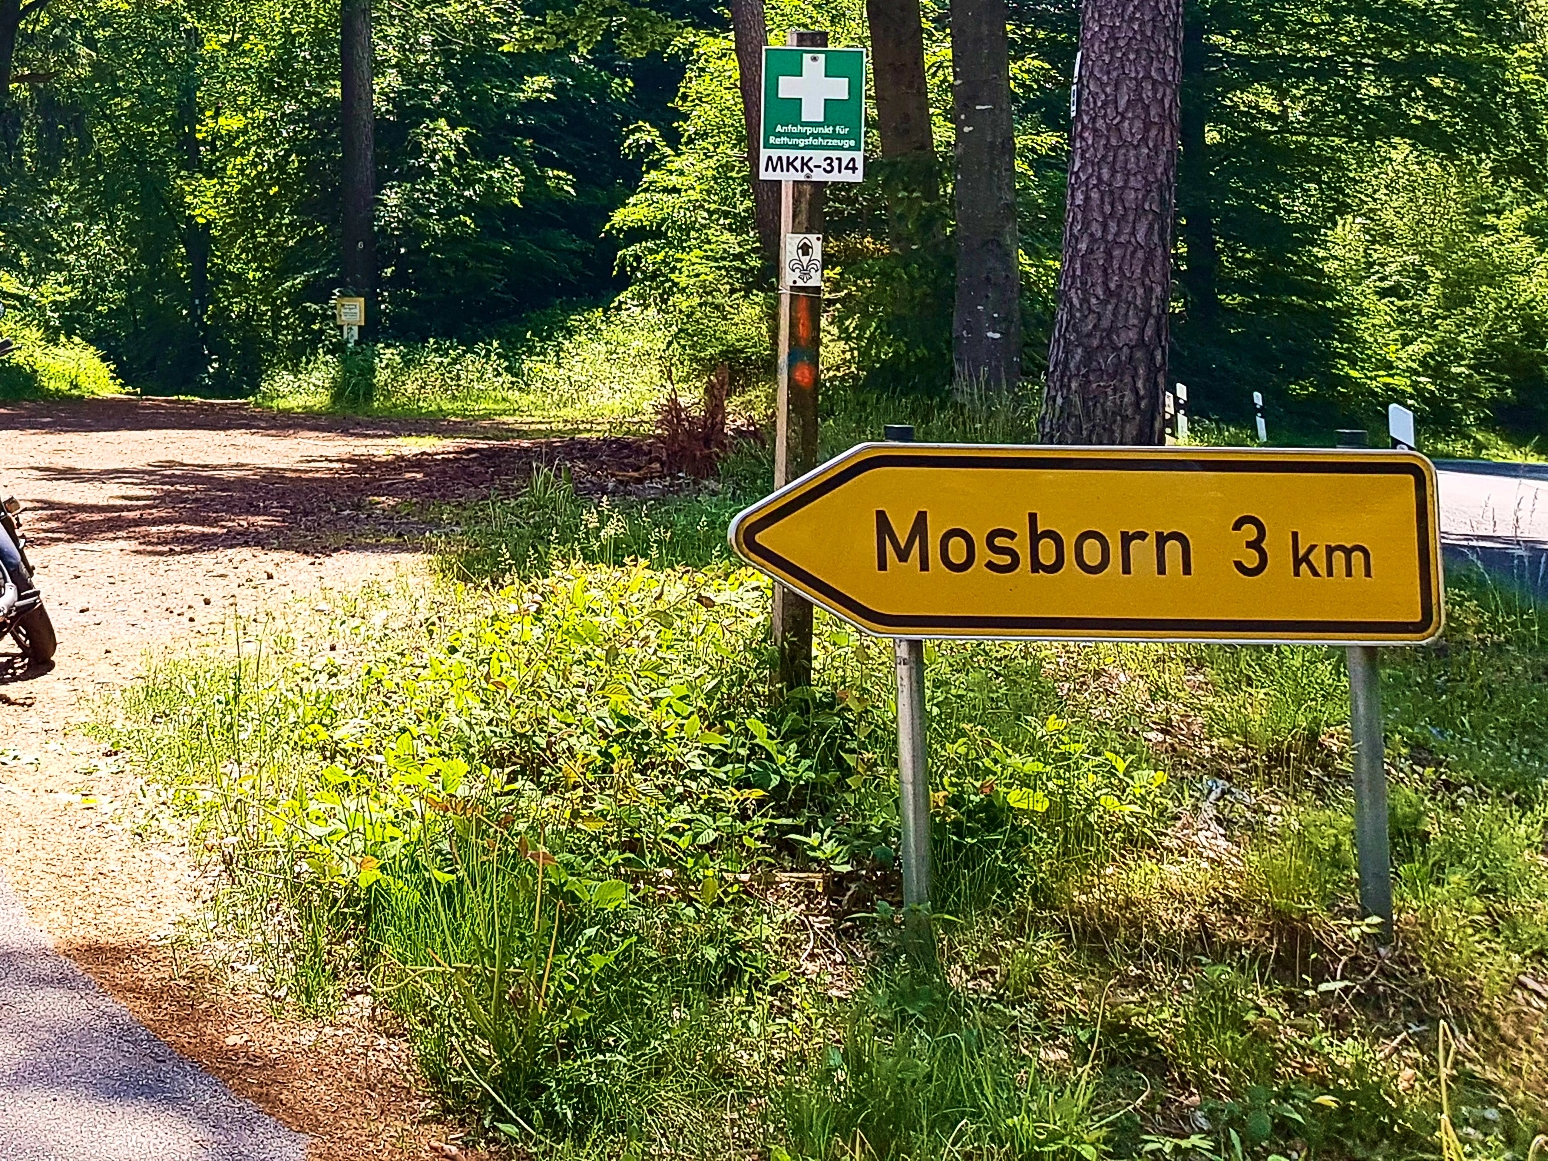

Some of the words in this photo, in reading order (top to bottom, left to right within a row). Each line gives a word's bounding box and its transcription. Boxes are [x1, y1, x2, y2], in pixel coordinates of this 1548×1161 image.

[775, 124, 833, 135] Anfahrpunkt
[835, 125, 850, 134] für
[769, 136, 856, 148] Rettungsfahrzeuge
[764, 155, 858, 174] MKK-314
[874, 509, 1193, 576] Mosborn
[1231, 514, 1269, 577] 3
[1291, 530, 1374, 579] km
